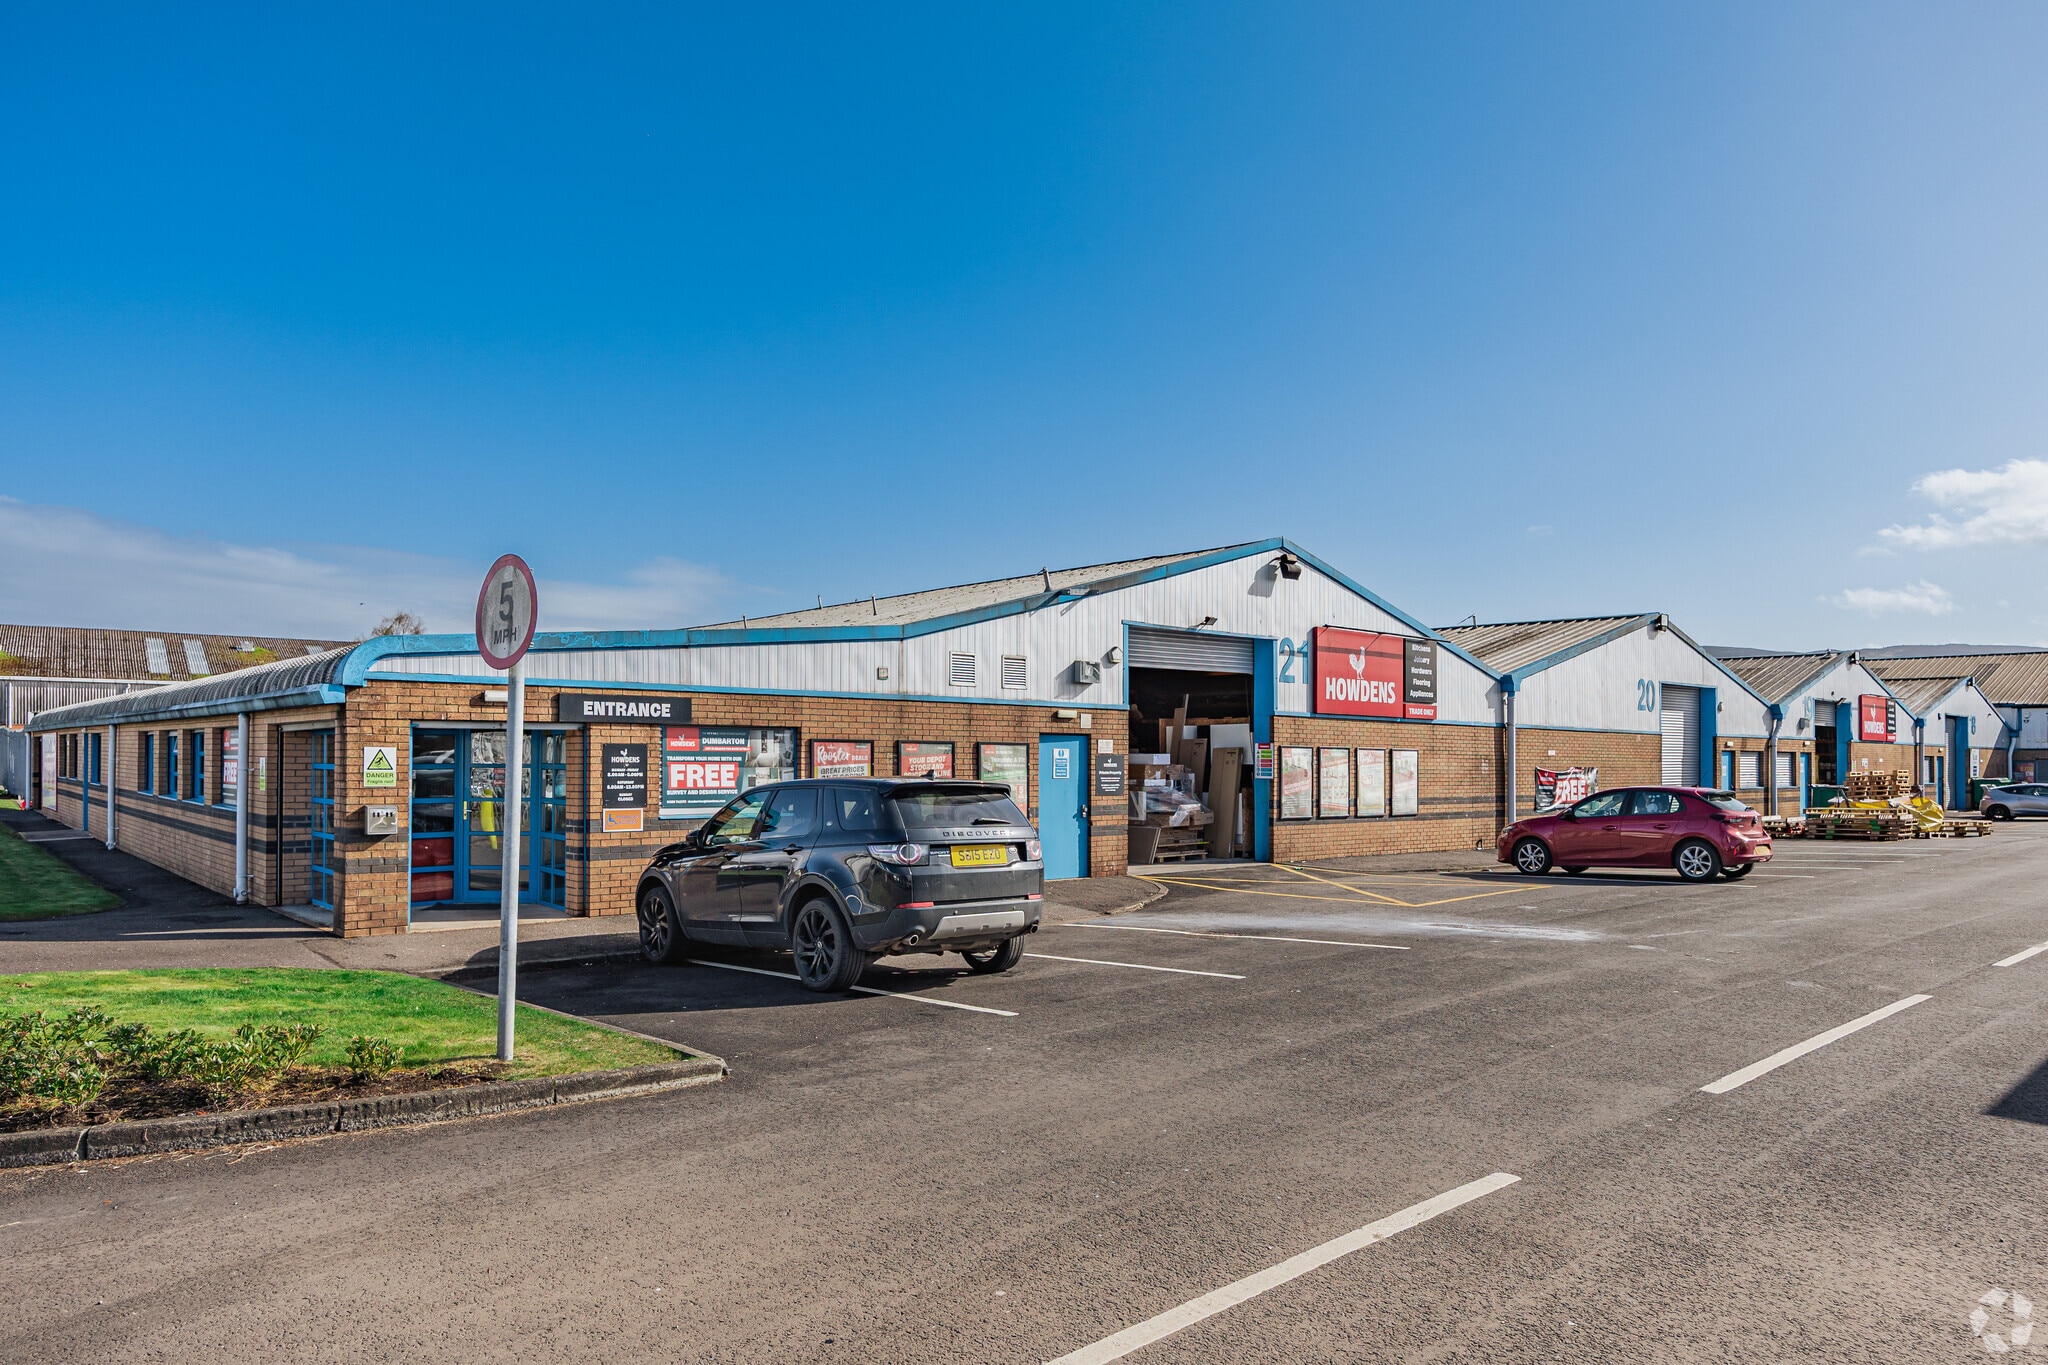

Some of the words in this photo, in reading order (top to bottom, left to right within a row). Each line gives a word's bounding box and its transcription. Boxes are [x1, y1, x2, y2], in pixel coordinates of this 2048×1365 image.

[499, 581, 514, 621] 5
[493, 627, 517, 645] MPH
[1279, 637, 1308, 684] 21
[1411, 666, 1432, 676] Hardware
[1325, 676, 1396, 704] HOWDENS
[1412, 678, 1431, 688] Flooring
[1409, 689, 1434, 698] Appliances
[1637, 678, 1656, 712] 20
[583, 701, 671, 717] ENTRANCE
[1408, 707, 1423, 715] TRADE
[702, 737, 745, 745] DUMBARTON
[817, 745, 850, 765] Rooster
[926, 755, 946, 763] DEPOT
[223, 761, 237, 783] FREE
[841, 765, 865, 773] PRICES
[931, 762, 944, 770] AND
[670, 763, 736, 787] FREE
[1554, 779, 1587, 802] FREE
